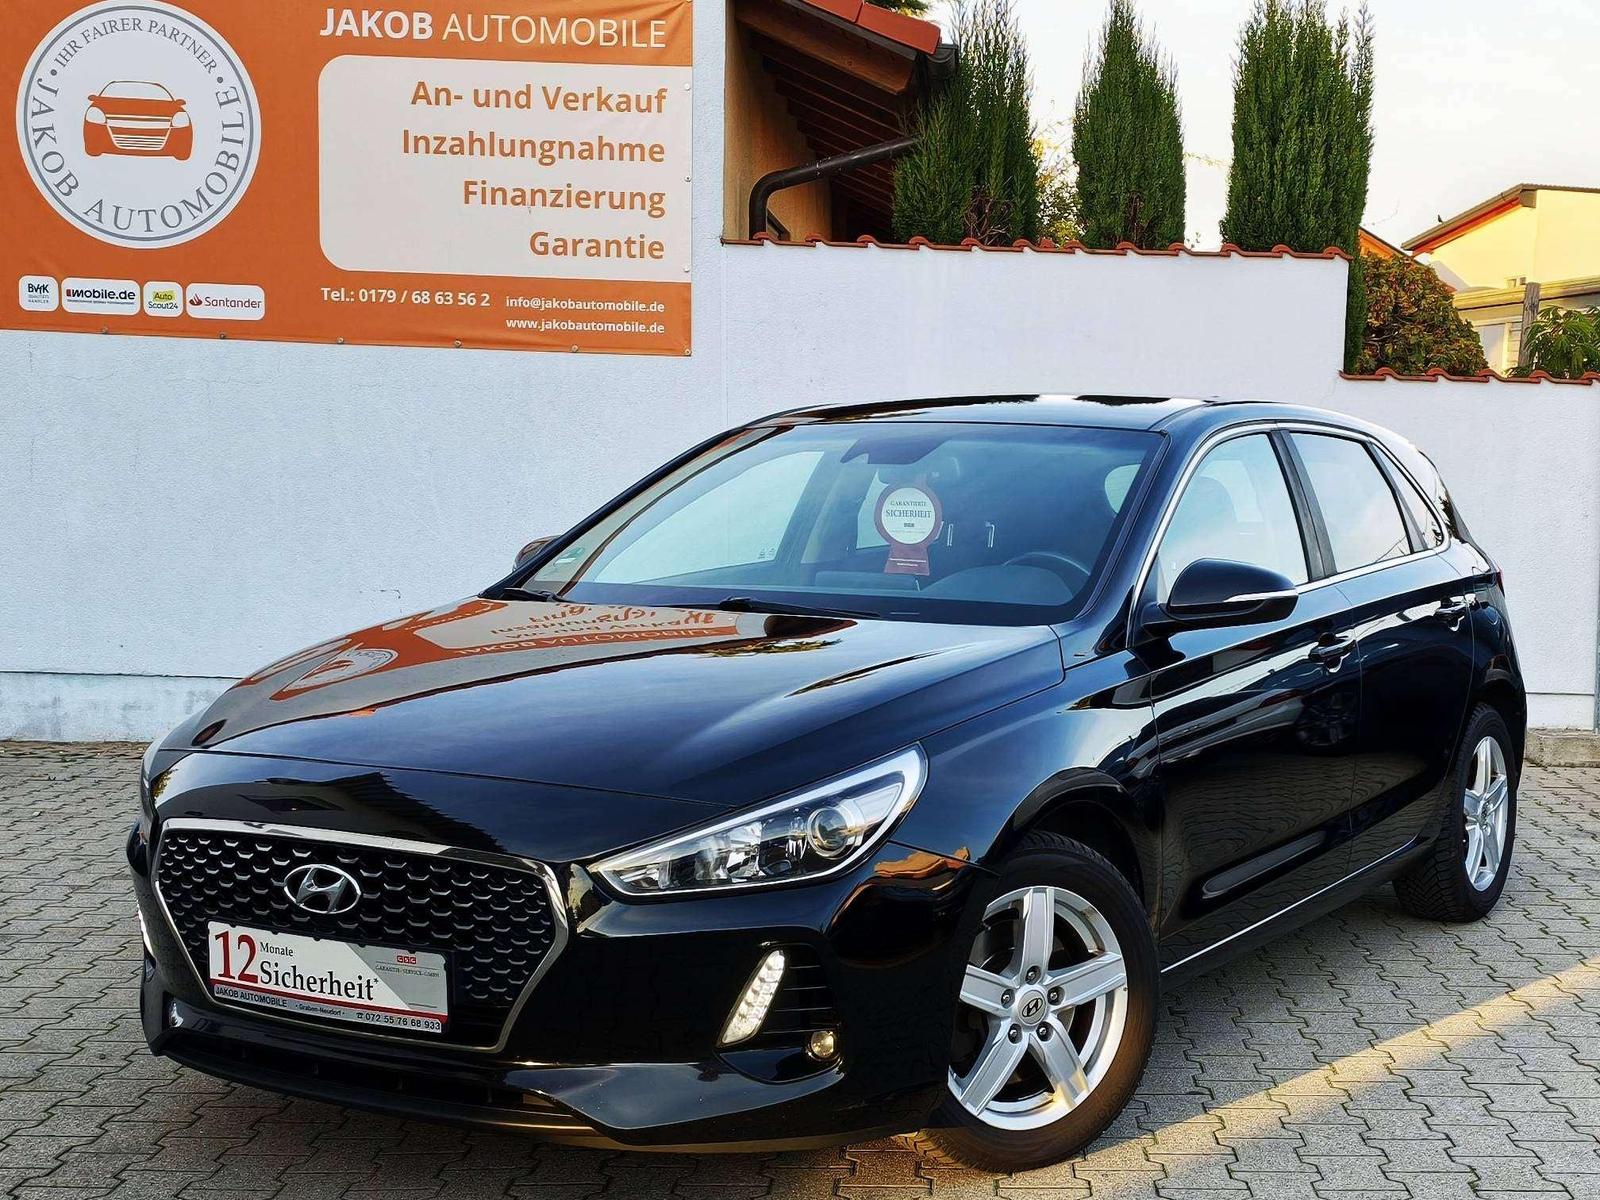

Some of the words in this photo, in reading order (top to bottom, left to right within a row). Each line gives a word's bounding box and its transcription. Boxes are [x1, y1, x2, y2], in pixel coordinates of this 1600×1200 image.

[320, 8, 434, 40] JAKOB
[442, 13, 667, 49] AUTOMOBILE
[54, 39, 83, 68] IHR
[81, 17, 143, 45] FAIRER
[148, 20, 218, 74] PARTNER
[411, 81, 463, 107] An-
[473, 84, 532, 110] und
[541, 86, 668, 114] Verkauf
[31, 77, 80, 197] JAKOB
[84, 85, 245, 233] AUTOMOBILE
[402, 129, 666, 166] Inzahlungnahme
[463, 180, 666, 218] Finanzierung
[529, 231, 665, 260] Garantie
[71, 289, 136, 300] mobile.de
[148, 301, 179, 310] Scout24
[153, 291, 173, 301] Auto
[204, 296, 262, 309] Santander
[320, 287, 355, 303] Tel.:
[358, 288, 397, 304] 0179
[400, 290, 408, 304] /
[411, 291, 431, 306] 68
[434, 291, 454, 306] 63
[457, 292, 477, 307] 56
[480, 293, 490, 307] 2
[505, 295, 665, 314] info@jakobautomobile.de
[505, 317, 665, 335] www.jakobautomobile.de
[886, 509, 932, 518] SICHERHEIT
[215, 930, 259, 984] 12
[260, 941, 294, 957] Monate
[216, 986, 239, 998] JAKOB
[240, 990, 287, 1008] AUTOMOBILE
[366, 1012, 381, 1023] 072
[384, 1014, 394, 1024] 55
[397, 1016, 408, 1026] 76
[410, 1018, 421, 1028] 68
[424, 1020, 441, 1030] 933
